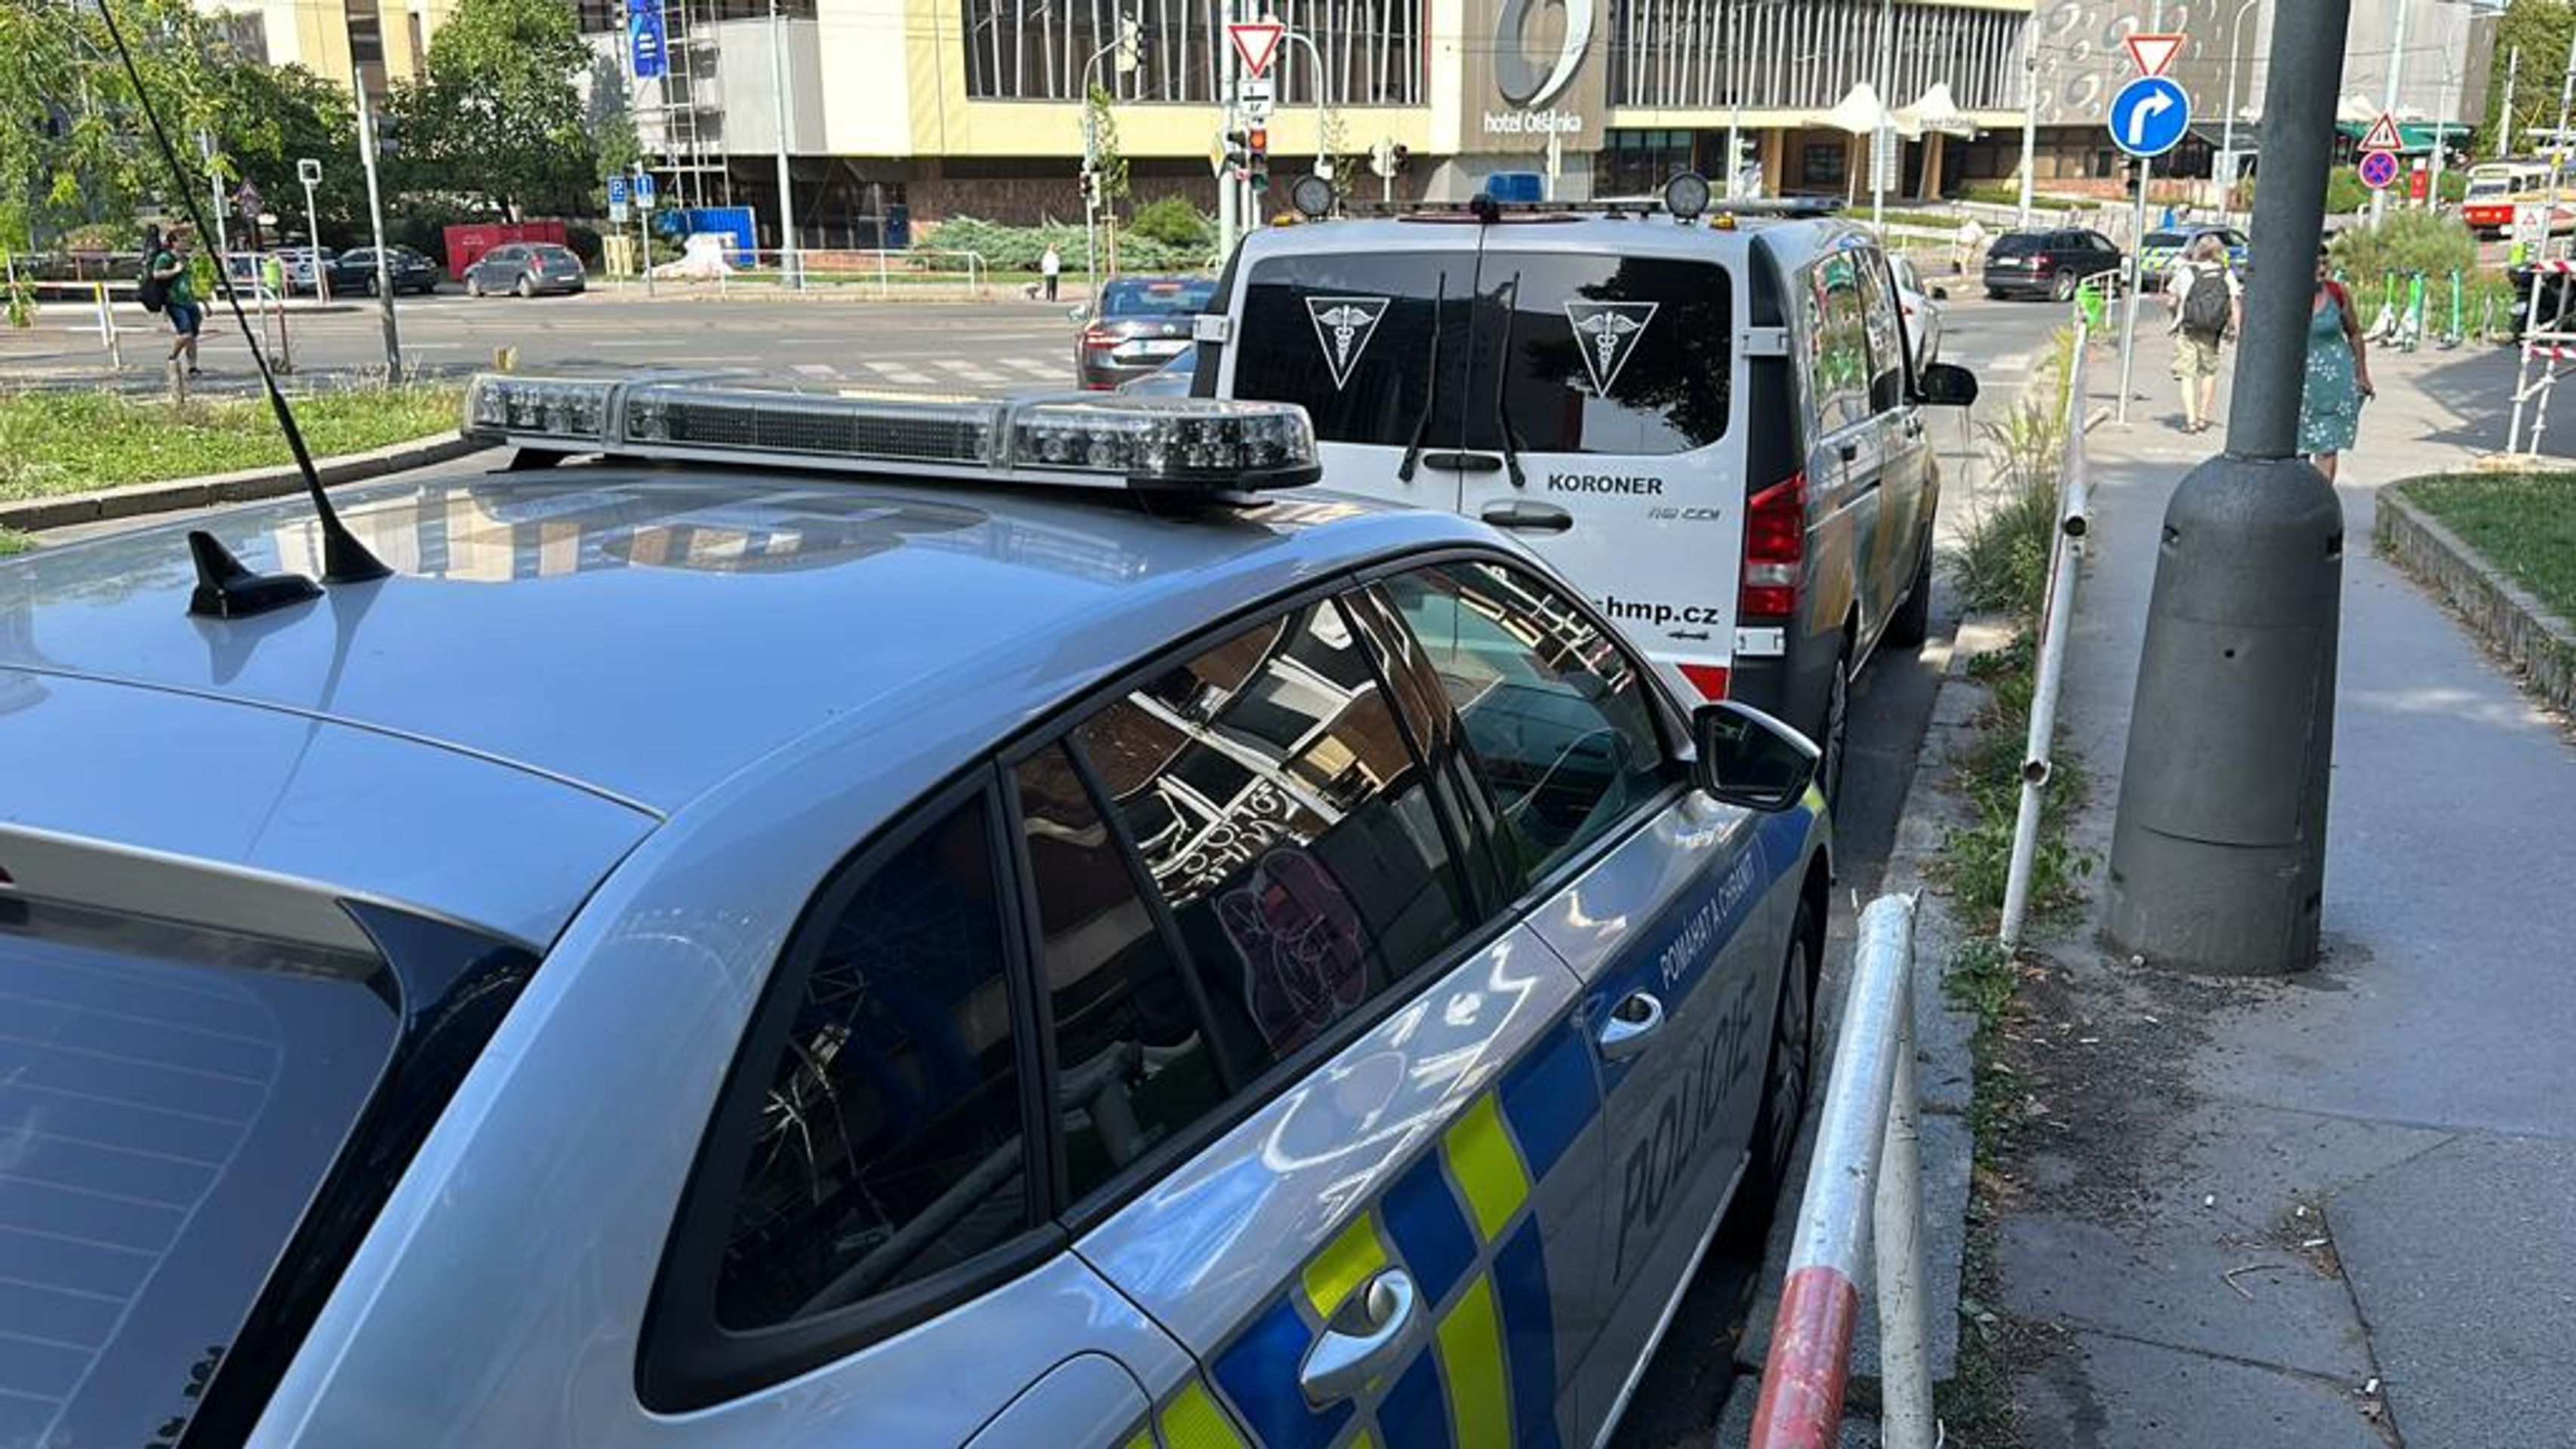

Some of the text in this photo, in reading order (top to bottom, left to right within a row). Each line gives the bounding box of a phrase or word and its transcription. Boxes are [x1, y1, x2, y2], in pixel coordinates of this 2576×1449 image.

[1484, 111, 1522, 133] hotel
[1549, 474, 1663, 494] KORONER
[1613, 968, 1756, 1287] POLICIE
